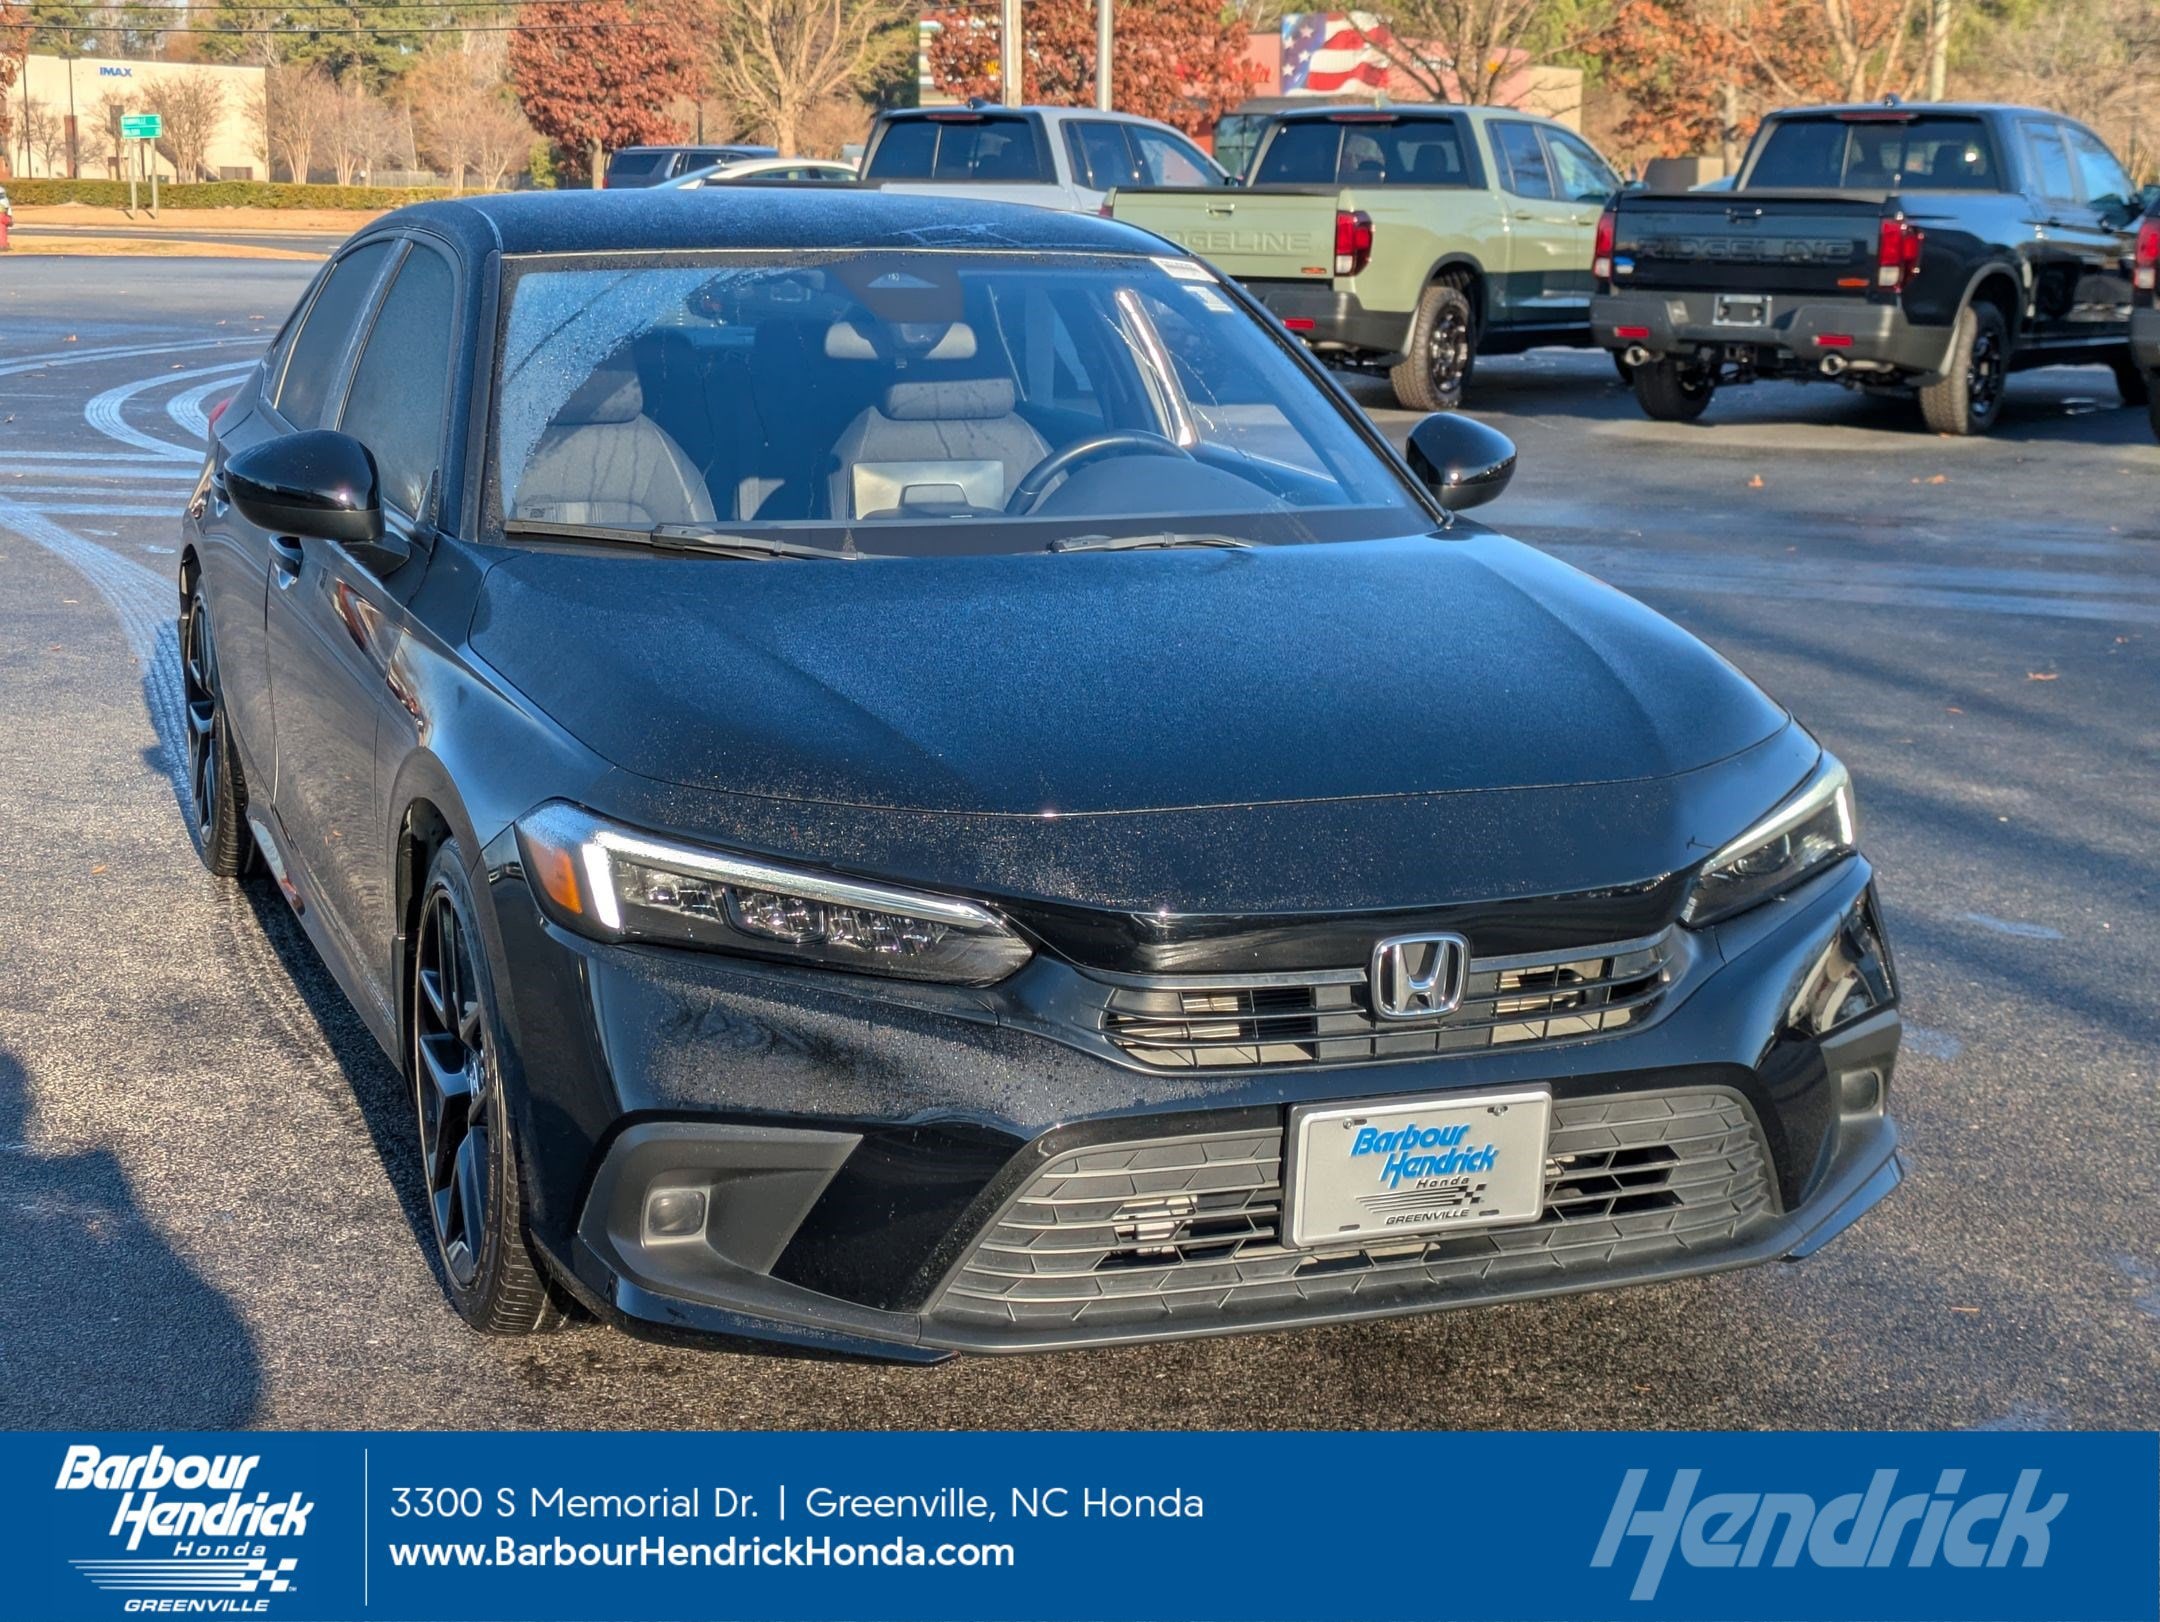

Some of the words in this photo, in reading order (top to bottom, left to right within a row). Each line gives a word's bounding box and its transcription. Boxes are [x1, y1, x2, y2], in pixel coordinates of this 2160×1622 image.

[99, 66, 133, 77] IMAX
[1163, 229, 1312, 253] DGELINE
[1638, 237, 1855, 264] RIDGELINE
[1350, 1123, 1470, 1157] Barbour
[1379, 1144, 1499, 1190] Hendrick
[1415, 1175, 1470, 1189] Honda
[1385, 1209, 1470, 1225] GREENVILLE
